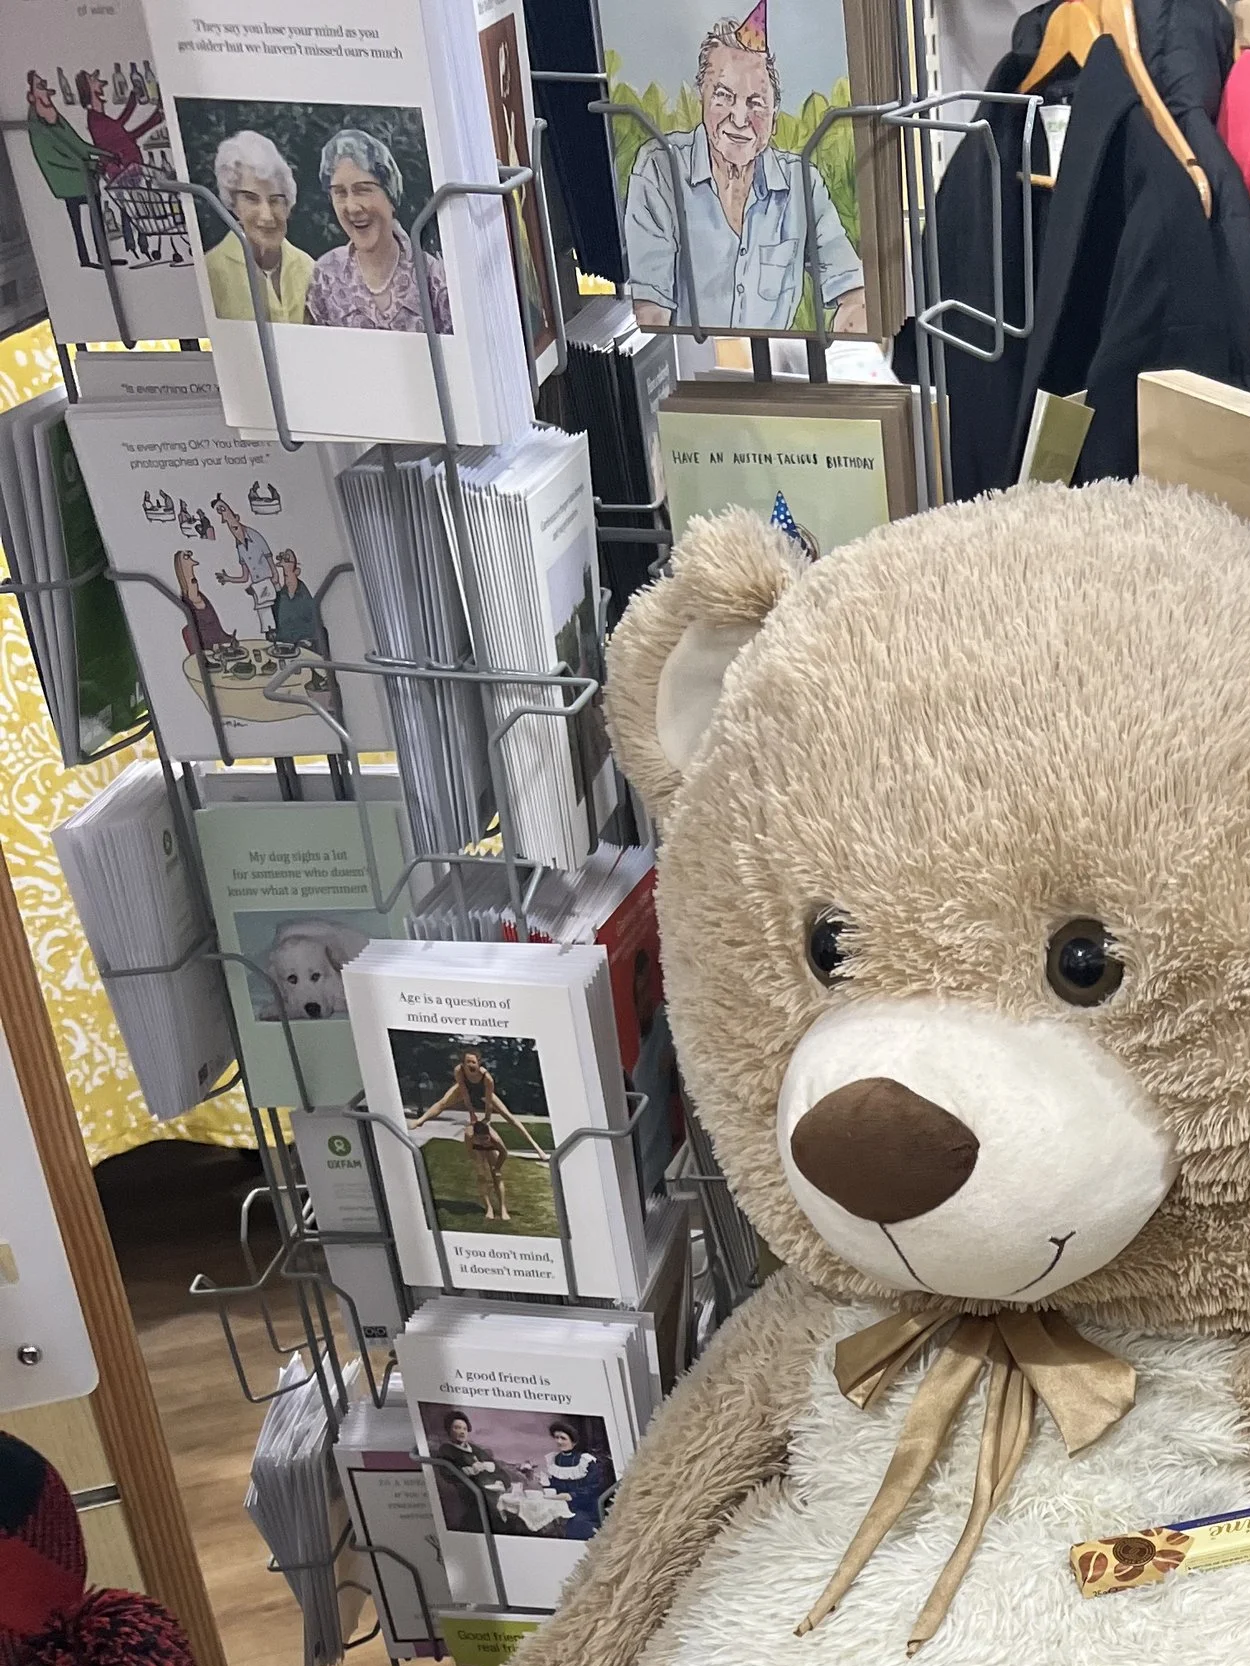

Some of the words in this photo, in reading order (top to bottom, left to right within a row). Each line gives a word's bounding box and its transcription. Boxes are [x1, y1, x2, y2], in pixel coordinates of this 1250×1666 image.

[191, 18, 221, 36] They
[222, 24, 241, 36] say
[241, 25, 263, 37] you
[263, 22, 286, 35] lose
[286, 26, 313, 39] your
[314, 24, 344, 37] mind
[345, 28, 358, 38] as
[358, 28, 380, 41] you
[195, 39, 223, 52] older
[223, 40, 244, 53] but
[244, 44, 261, 54] we
[262, 41, 303, 55] haven't
[304, 44, 344, 57] missed
[344, 47, 369, 58] ours
[370, 46, 403, 60] much
[136, 440, 188, 453] everything
[188, 439, 210, 450] OK?
[211, 438, 232, 449] You
[130, 455, 200, 471] photographed
[201, 457, 222, 468] your
[224, 454, 248, 465] food
[672, 450, 701, 465] HAVE
[710, 451, 724, 464] AN
[826, 455, 876, 471] BIRTHDAY
[250, 851, 267, 865] My
[269, 850, 291, 864] dog
[292, 850, 321, 864] sighs
[323, 852, 331, 862] a
[332, 849, 348, 862] lot
[232, 868, 249, 880] for
[251, 868, 302, 880] someone
[304, 867, 329, 878] who
[331, 866, 367, 878] doesn'
[227, 885, 259, 897] know
[260, 884, 290, 896] what
[291, 886, 299, 896] a
[300, 883, 369, 898] government
[400, 991, 422, 1006] Age
[424, 993, 434, 1005] is
[436, 996, 443, 1005] a
[445, 997, 498, 1009] question
[499, 998, 512, 1010] of
[407, 1013, 438, 1023] mind
[440, 1017, 468, 1026] over
[470, 1018, 510, 1029] matter
[327, 1160, 362, 1170] OXFAM
[453, 1246, 463, 1257] If
[464, 1249, 487, 1259] you
[489, 1248, 517, 1260] don't
[520, 1251, 555, 1264] mind,
[460, 1264, 468, 1274] it
[470, 1265, 511, 1277] doesn't
[513, 1268, 556, 1280] matter.
[454, 1369, 463, 1380] A
[466, 1370, 497, 1382] good
[498, 1371, 538, 1386] friend
[539, 1375, 551, 1386] is
[439, 1382, 491, 1398] cheaper
[491, 1386, 522, 1400] than
[523, 1389, 573, 1405] therapy
[457, 1630, 490, 1641] Good
[477, 1643, 501, 1653] real
